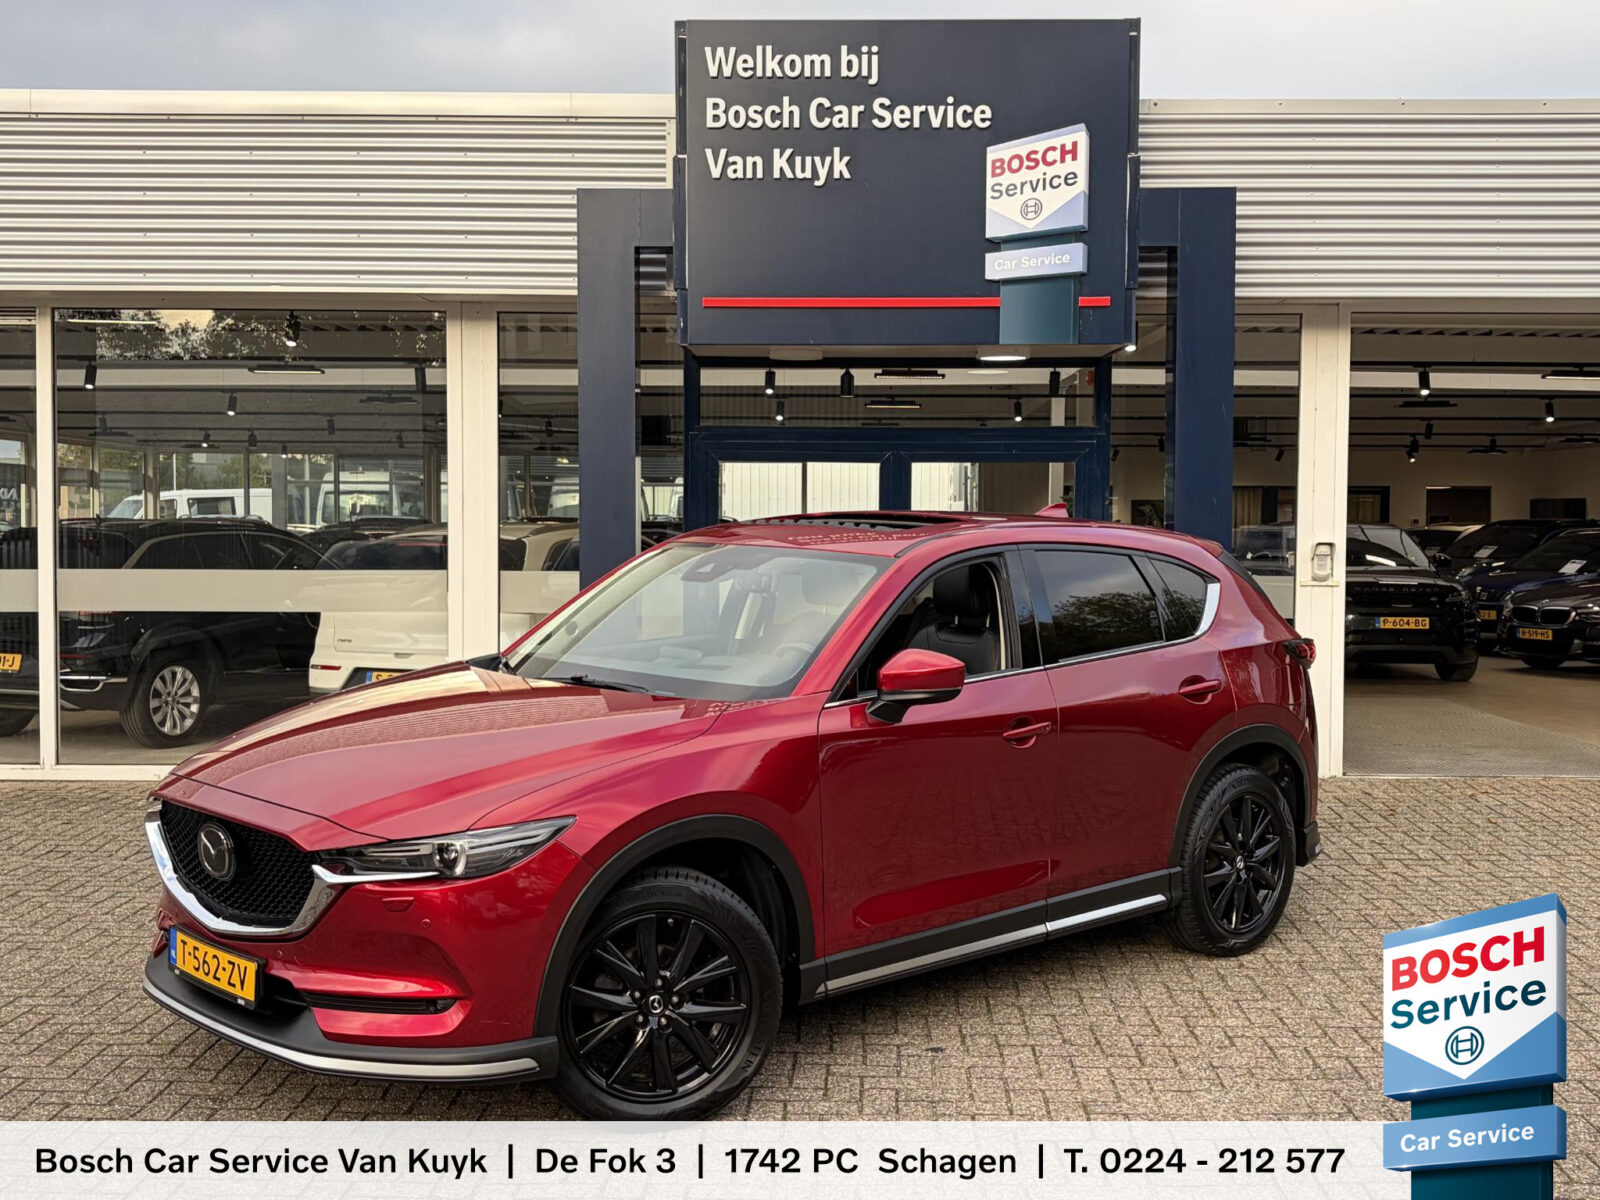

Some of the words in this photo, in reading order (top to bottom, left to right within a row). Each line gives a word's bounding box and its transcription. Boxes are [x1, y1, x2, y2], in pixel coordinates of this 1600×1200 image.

[704, 45, 831, 78] Welkom
[840, 45, 879, 85] bij
[705, 96, 800, 129] Bosch
[809, 97, 865, 129] Car
[871, 96, 992, 129] Service
[704, 148, 763, 179] Van
[773, 147, 851, 187] Kuyk
[991, 140, 1078, 178] BOSCH
[990, 171, 1079, 200] Service
[994, 258, 1017, 271] Car
[1020, 253, 1071, 269] Service
[1382, 618, 1427, 628] P-604-BG
[180, 938, 248, 992] T-562-ZV
